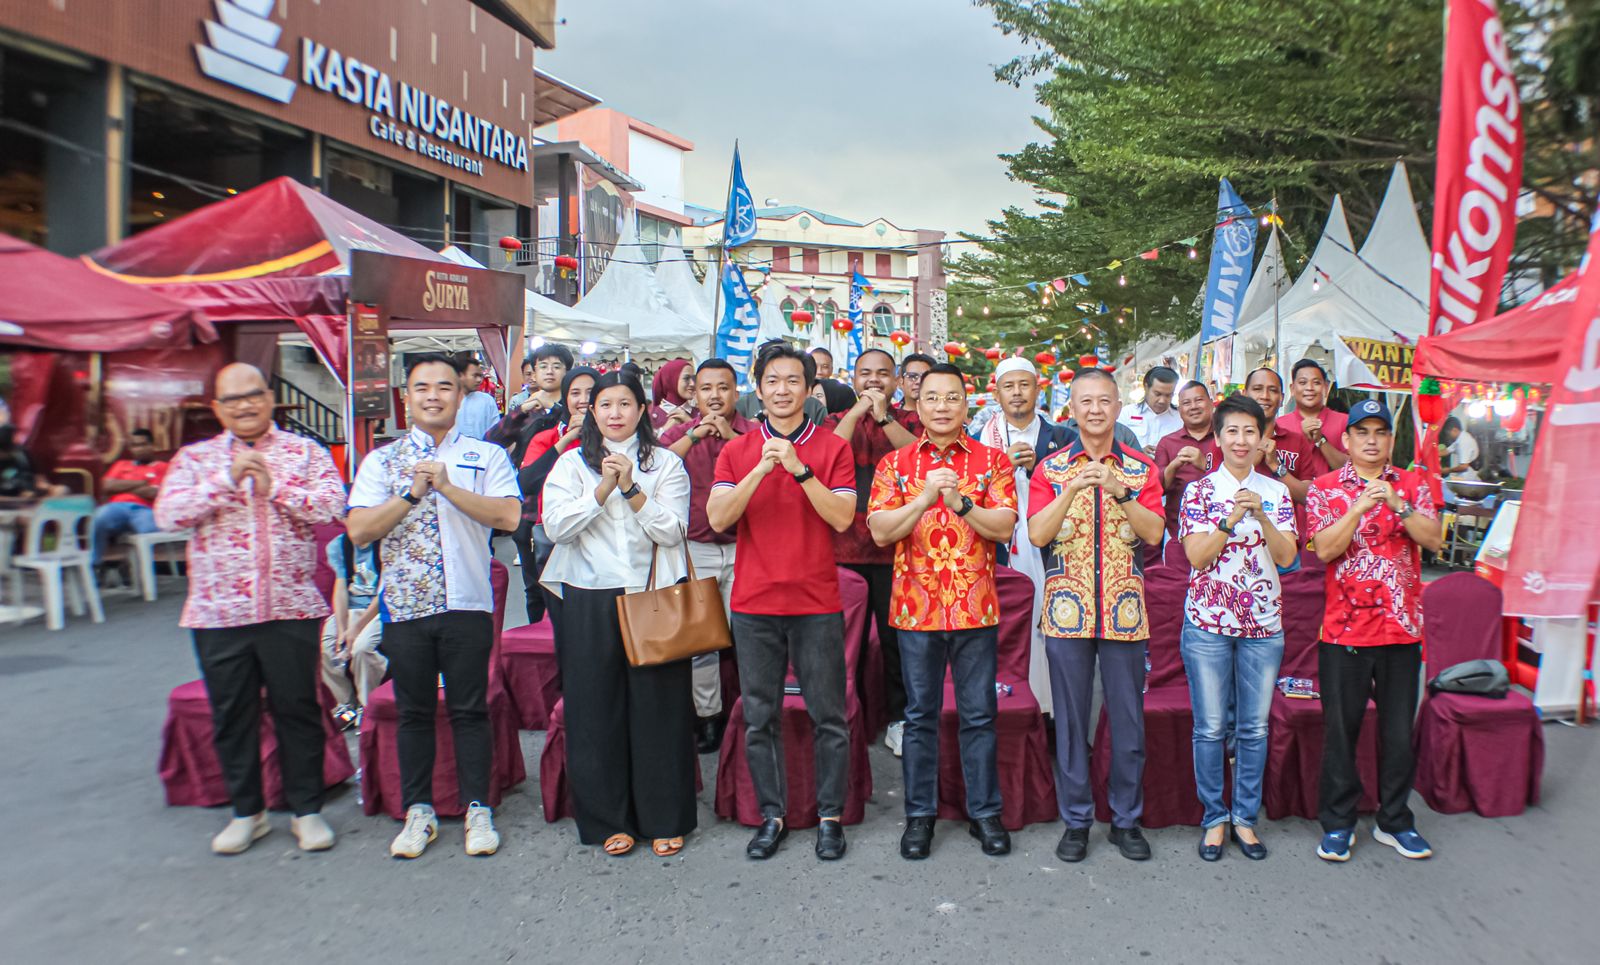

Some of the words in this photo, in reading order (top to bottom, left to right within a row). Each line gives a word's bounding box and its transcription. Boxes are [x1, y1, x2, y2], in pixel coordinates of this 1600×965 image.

[301, 37, 396, 119] KASTA
[399, 80, 529, 173] NUSANTARA
[369, 114, 404, 147] Cafe
[405, 130, 417, 151] &
[418, 133, 484, 177] Restaurant
[1433, 0, 1520, 336] lkomse
[422, 269, 470, 312] SURYA
[1345, 340, 1400, 363] WAN
[1367, 363, 1413, 385] ATA
